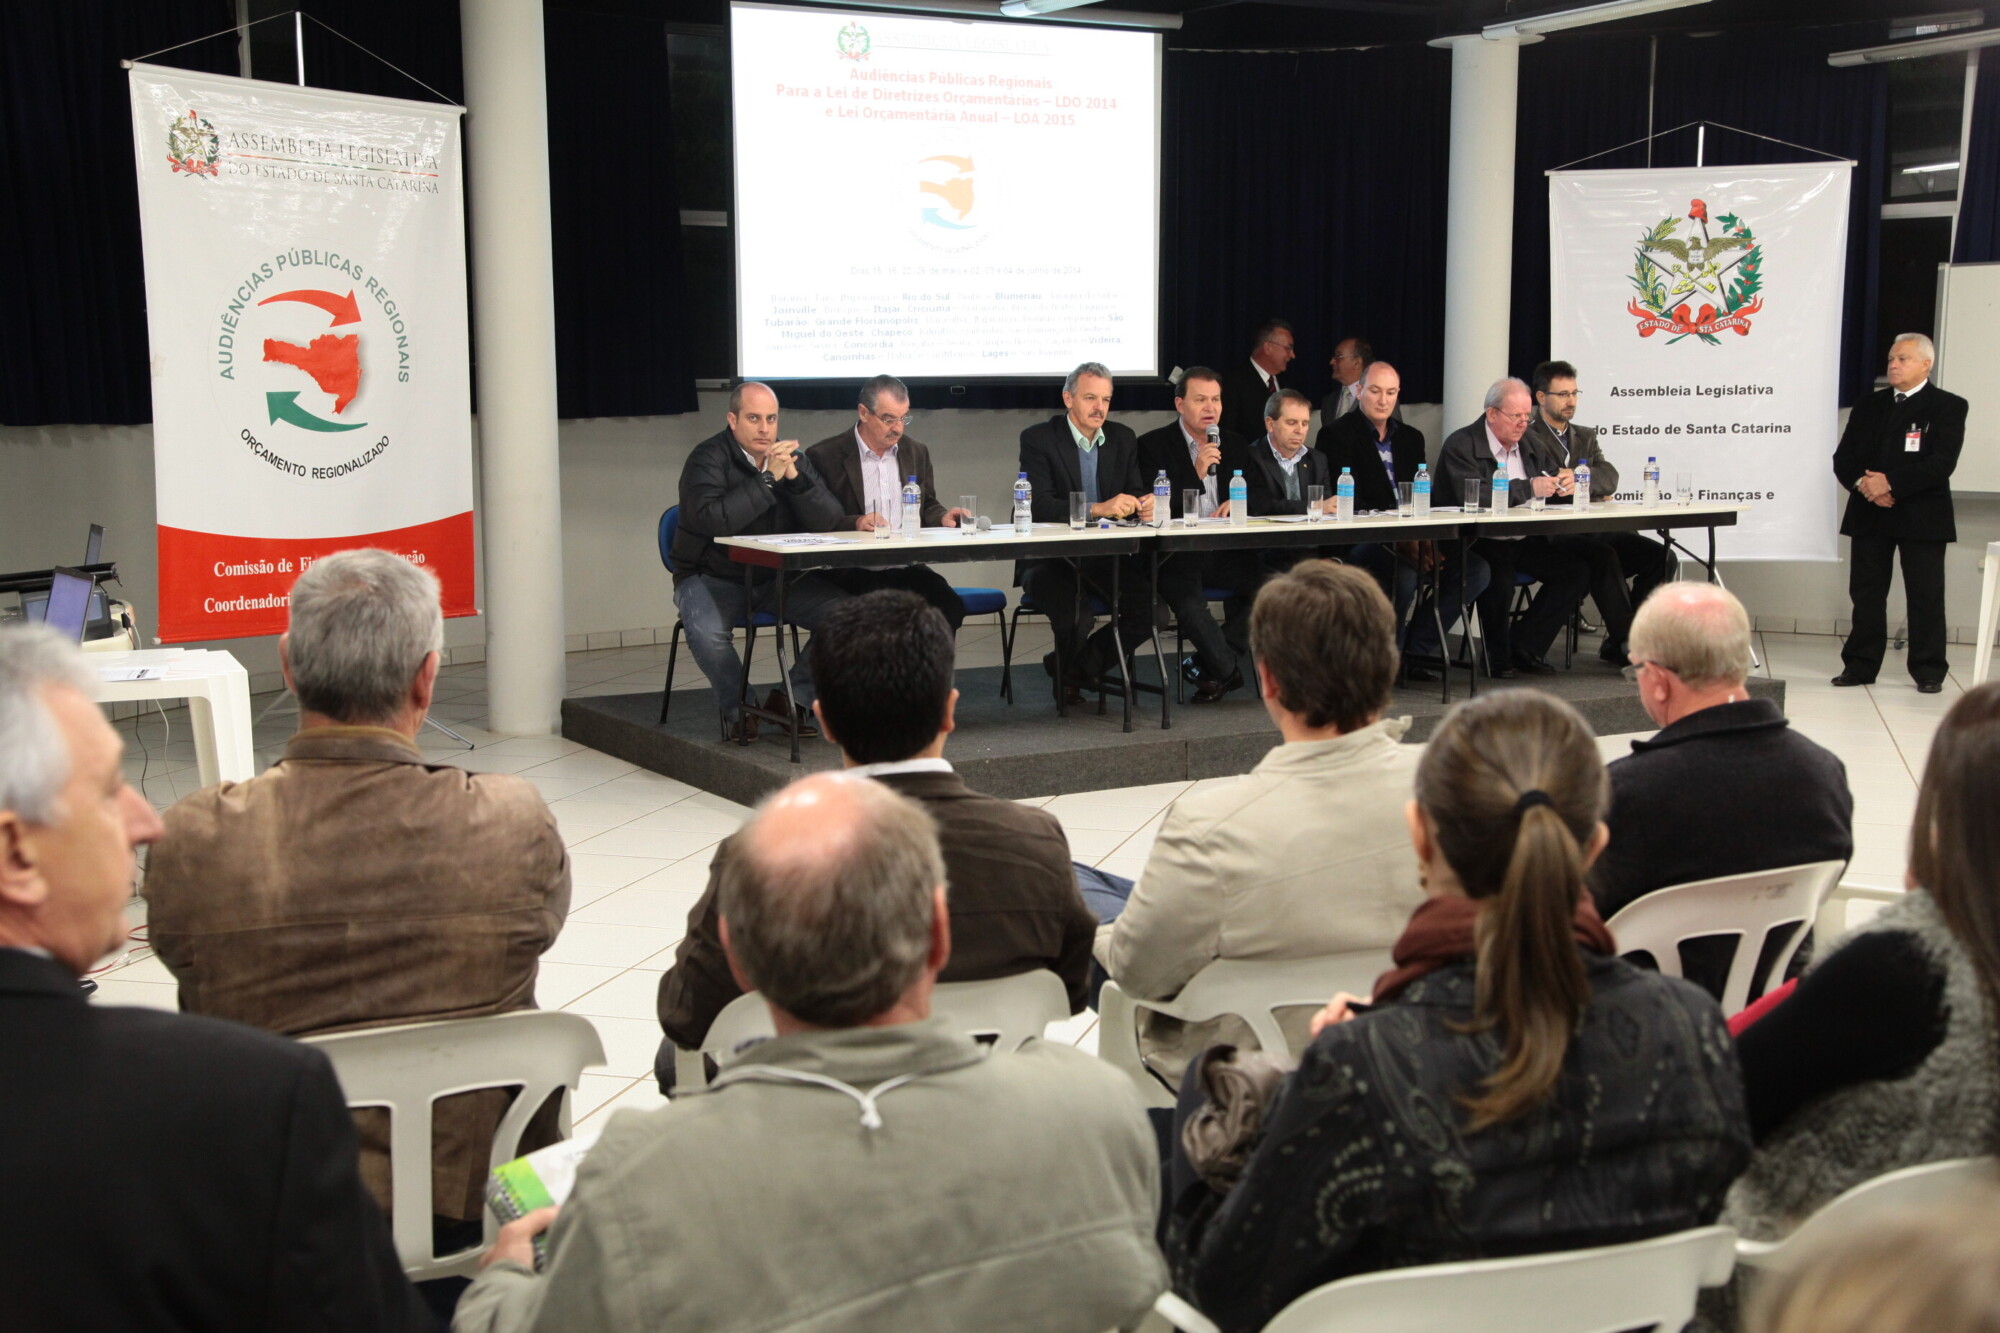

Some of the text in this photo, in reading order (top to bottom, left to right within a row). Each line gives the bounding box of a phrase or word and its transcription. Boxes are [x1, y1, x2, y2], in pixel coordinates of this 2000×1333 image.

[928, 71, 985, 87] Públicas
[988, 74, 1053, 91] Regionais
[776, 84, 808, 98] Para
[813, 88, 822, 98] a
[826, 86, 847, 99] Lei
[851, 87, 868, 100] de
[873, 88, 939, 103] Diretrizes
[1055, 95, 1082, 109] LDO
[1086, 96, 1117, 110] 2014
[825, 108, 833, 118] e
[838, 105, 859, 119] Lei
[959, 110, 998, 124] Anual
[1013, 111, 1040, 125] LOA
[1044, 113, 1075, 127] 2015
[228, 132, 439, 170] ASSEMBLEIA LEGISLATIVA
[228, 161, 250, 176] DO
[256, 164, 309, 181] ESTADO
[313, 170, 330, 184] DE
[335, 172, 374, 189] SANTA
[377, 176, 439, 194] CATARINA
[218, 247, 410, 383] AUDIÊNCIAS PÚBLICAS REGIONAIS
[1639, 320, 1670, 330] ESTADO
[1671, 324, 1681, 333] DE
[1715, 318, 1749, 329] CATARINA
[1610, 384, 1774, 399] Assembleia Legislativa
[1612, 424, 1660, 436] Estado
[1664, 424, 1682, 435] de
[1686, 423, 1727, 435] Santa
[1731, 422, 1792, 434] Catarina
[240, 428, 390, 479] ORÇAMENTO REGIONALIZADO
[1698, 489, 1762, 503] Finanças
[1766, 491, 1775, 500] e
[213, 559, 274, 577] Comissão
[277, 558, 293, 574] de
[204, 591, 291, 613] Coordenadori
